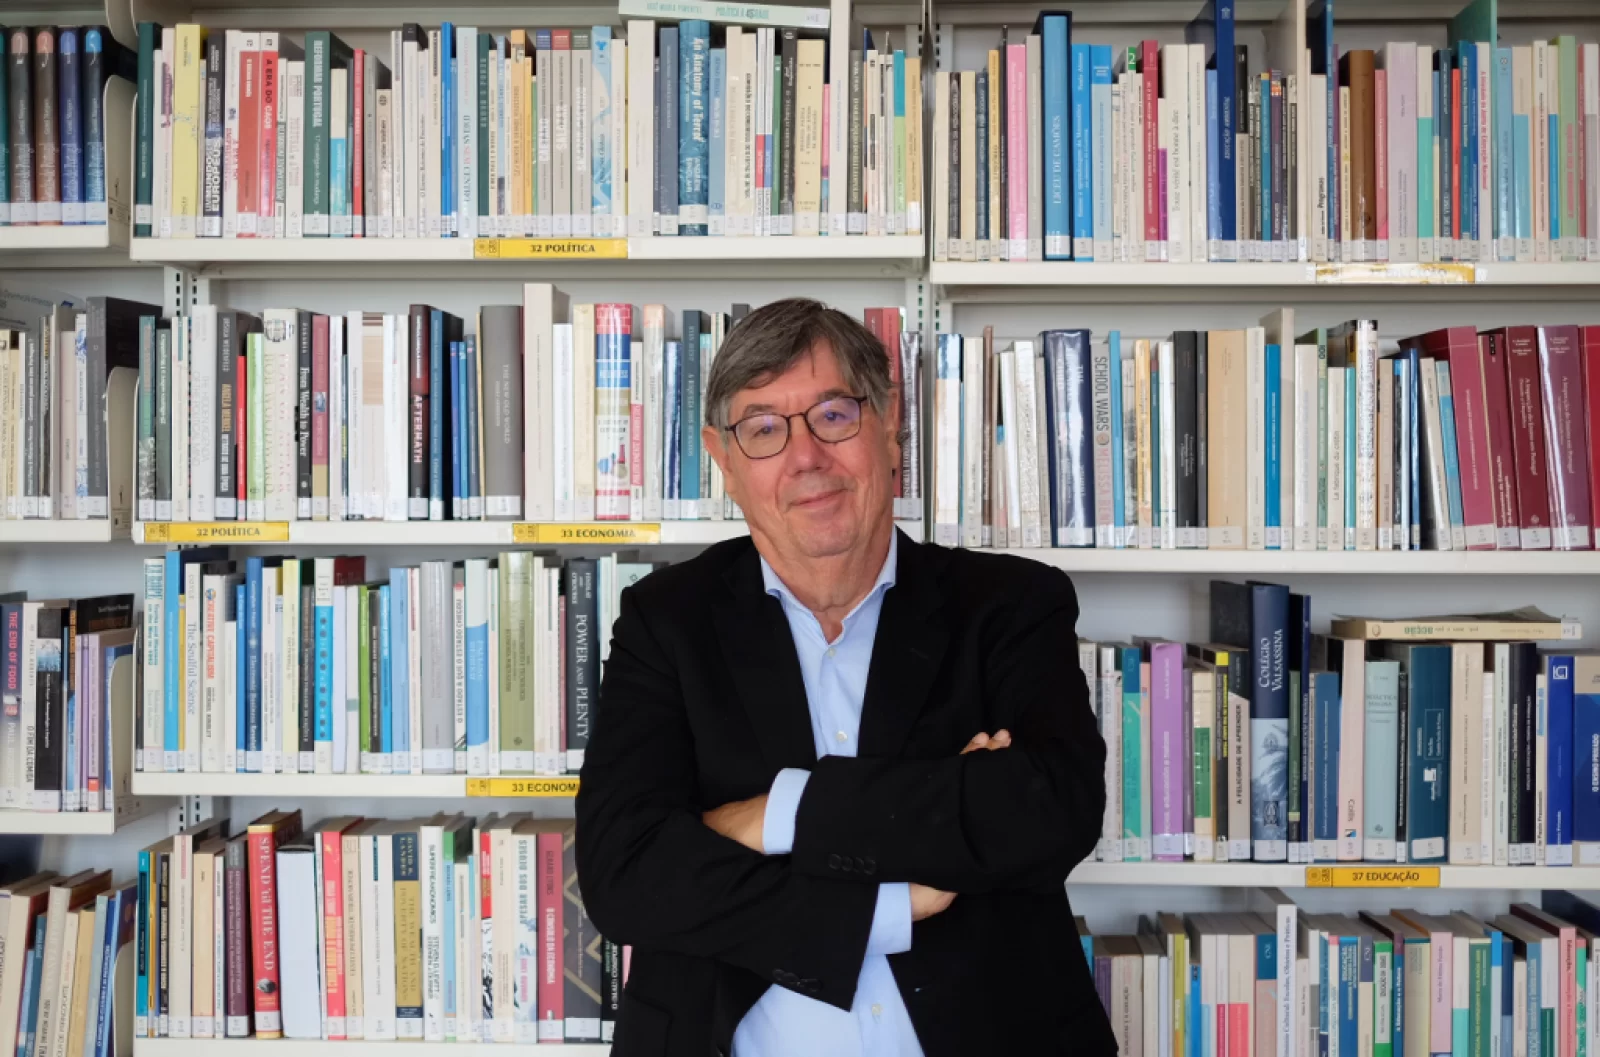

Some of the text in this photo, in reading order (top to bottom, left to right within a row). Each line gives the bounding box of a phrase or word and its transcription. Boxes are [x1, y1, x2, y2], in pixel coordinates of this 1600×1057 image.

[312, 40, 322, 127] REFORMAR PORTUGAL
[1128, 53, 1136, 66] 2
[265, 90, 272, 103] DO
[691, 38, 705, 141] An Anatomy of Terror
[212, 139, 220, 211] EUROPEUS
[1051, 115, 1061, 204] LICEU DE CAMÕES
[530, 242, 596, 253] 32 POLÍTICA
[222, 384, 231, 432] ANGELA MERKEL
[300, 367, 309, 456] From Wealth to Power
[1094, 356, 1110, 431] SCHOOL WARS
[264, 354, 273, 494] BOB WOODWARD
[413, 395, 423, 463] AFTERMATH
[192, 443, 200, 467] MIND
[1096, 448, 1111, 495] MELISSA
[1332, 431, 1341, 500] La fabrique du crétin
[196, 525, 260, 537] 32 POLÍTICA
[561, 528, 636, 539] 33 ECONOMIA
[8, 612, 18, 689] THE END OF FOOD
[207, 600, 215, 679] CREATIVE CAPITALISM
[1404, 626, 1434, 634] acção
[187, 623, 197, 715] The Soulful Science
[456, 665, 464, 679] QUE
[575, 614, 588, 739] POWER AND PLENTY
[1258, 638, 1270, 688] COLÉGIO
[1272, 629, 1283, 691] VALSASSINA
[26, 733, 35, 745] FIM
[26, 746, 35, 755] DA
[1236, 745, 1242, 754] DE
[26, 757, 35, 782] COMIDA
[512, 783, 579, 792] 33 ECONOM
[519, 840, 527, 924] APESAR DOS DEUSES
[1352, 870, 1420, 882] 37 EDUCAÇÃO
[259, 838, 275, 970] SPEND 'til THE END
